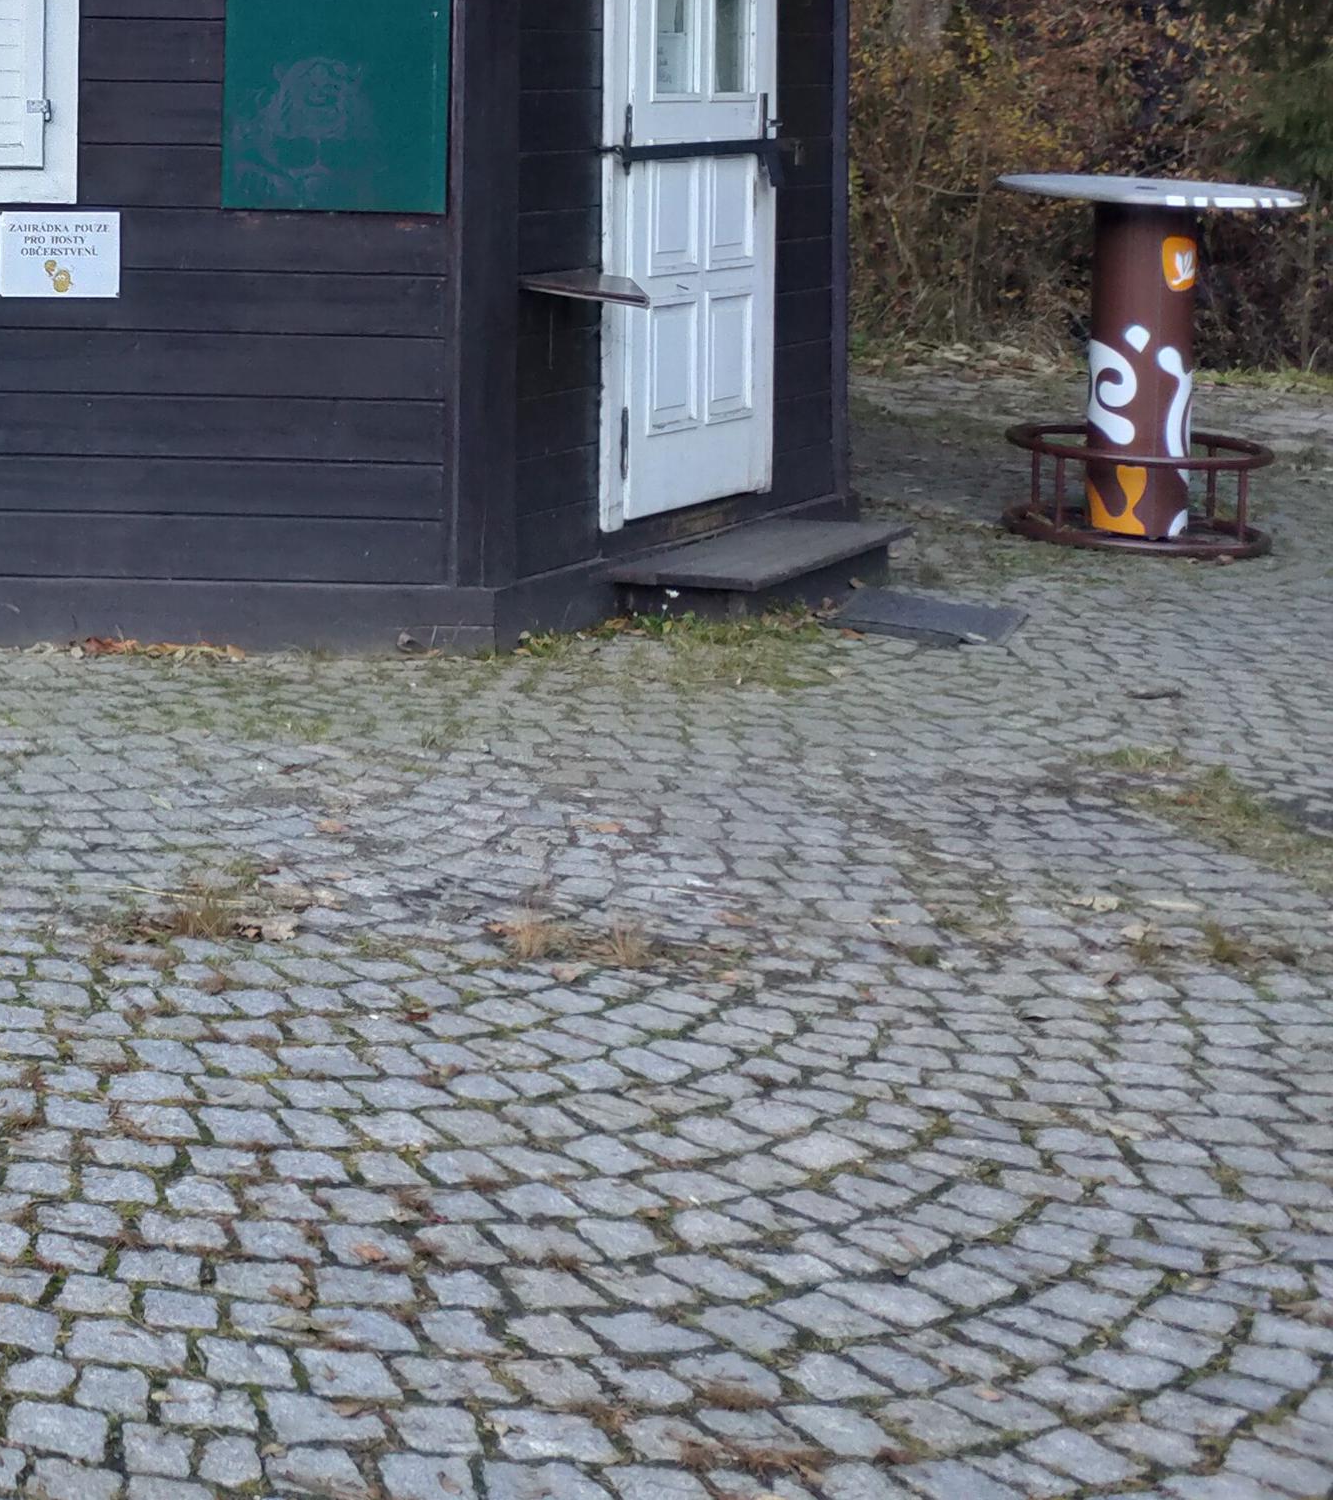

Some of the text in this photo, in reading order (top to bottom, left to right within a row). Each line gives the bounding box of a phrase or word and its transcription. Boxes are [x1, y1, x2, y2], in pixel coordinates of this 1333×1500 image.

[9, 221, 110, 233] ZAHRÁDKA POUZE
[24, 235, 85, 244] PRO HOSTY
